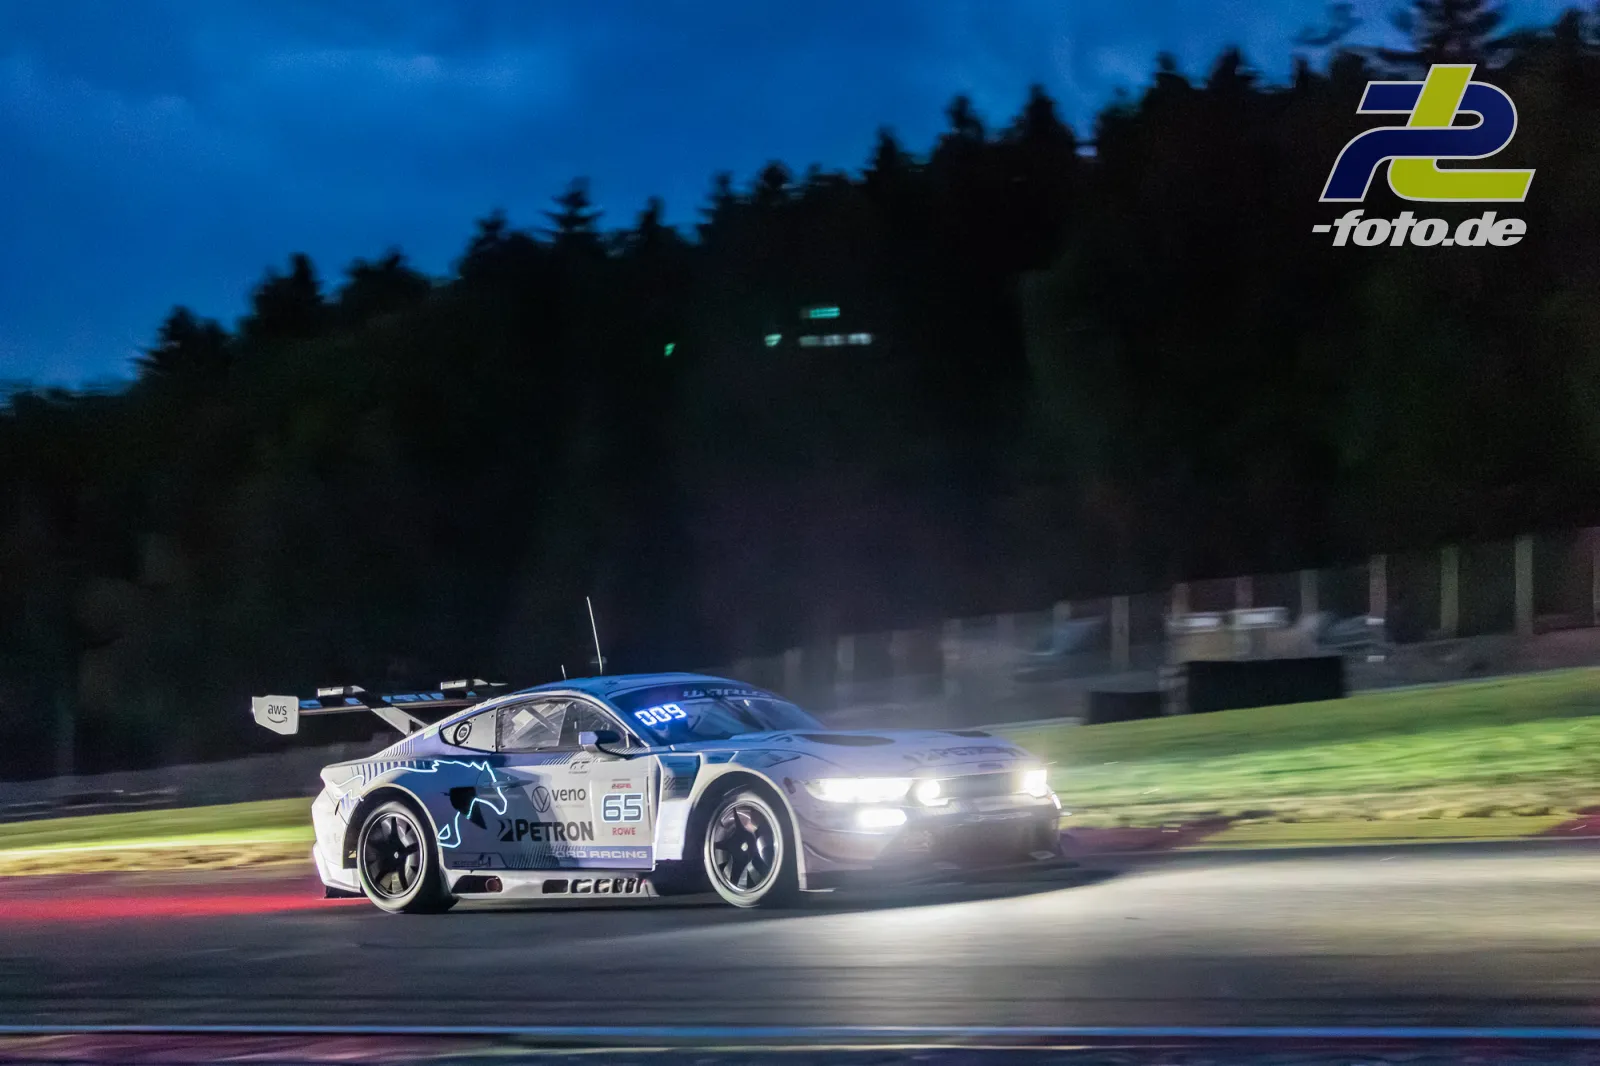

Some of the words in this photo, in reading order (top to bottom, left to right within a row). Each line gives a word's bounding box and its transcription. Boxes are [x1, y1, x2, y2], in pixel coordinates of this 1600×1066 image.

[267, 704, 287, 716] aws
[634, 703, 687, 726] 009
[552, 788, 586, 801] veno
[602, 793, 643, 822] 65
[515, 818, 594, 841] PETRON
[612, 827, 636, 836] ROWE
[589, 850, 648, 858] RACING
